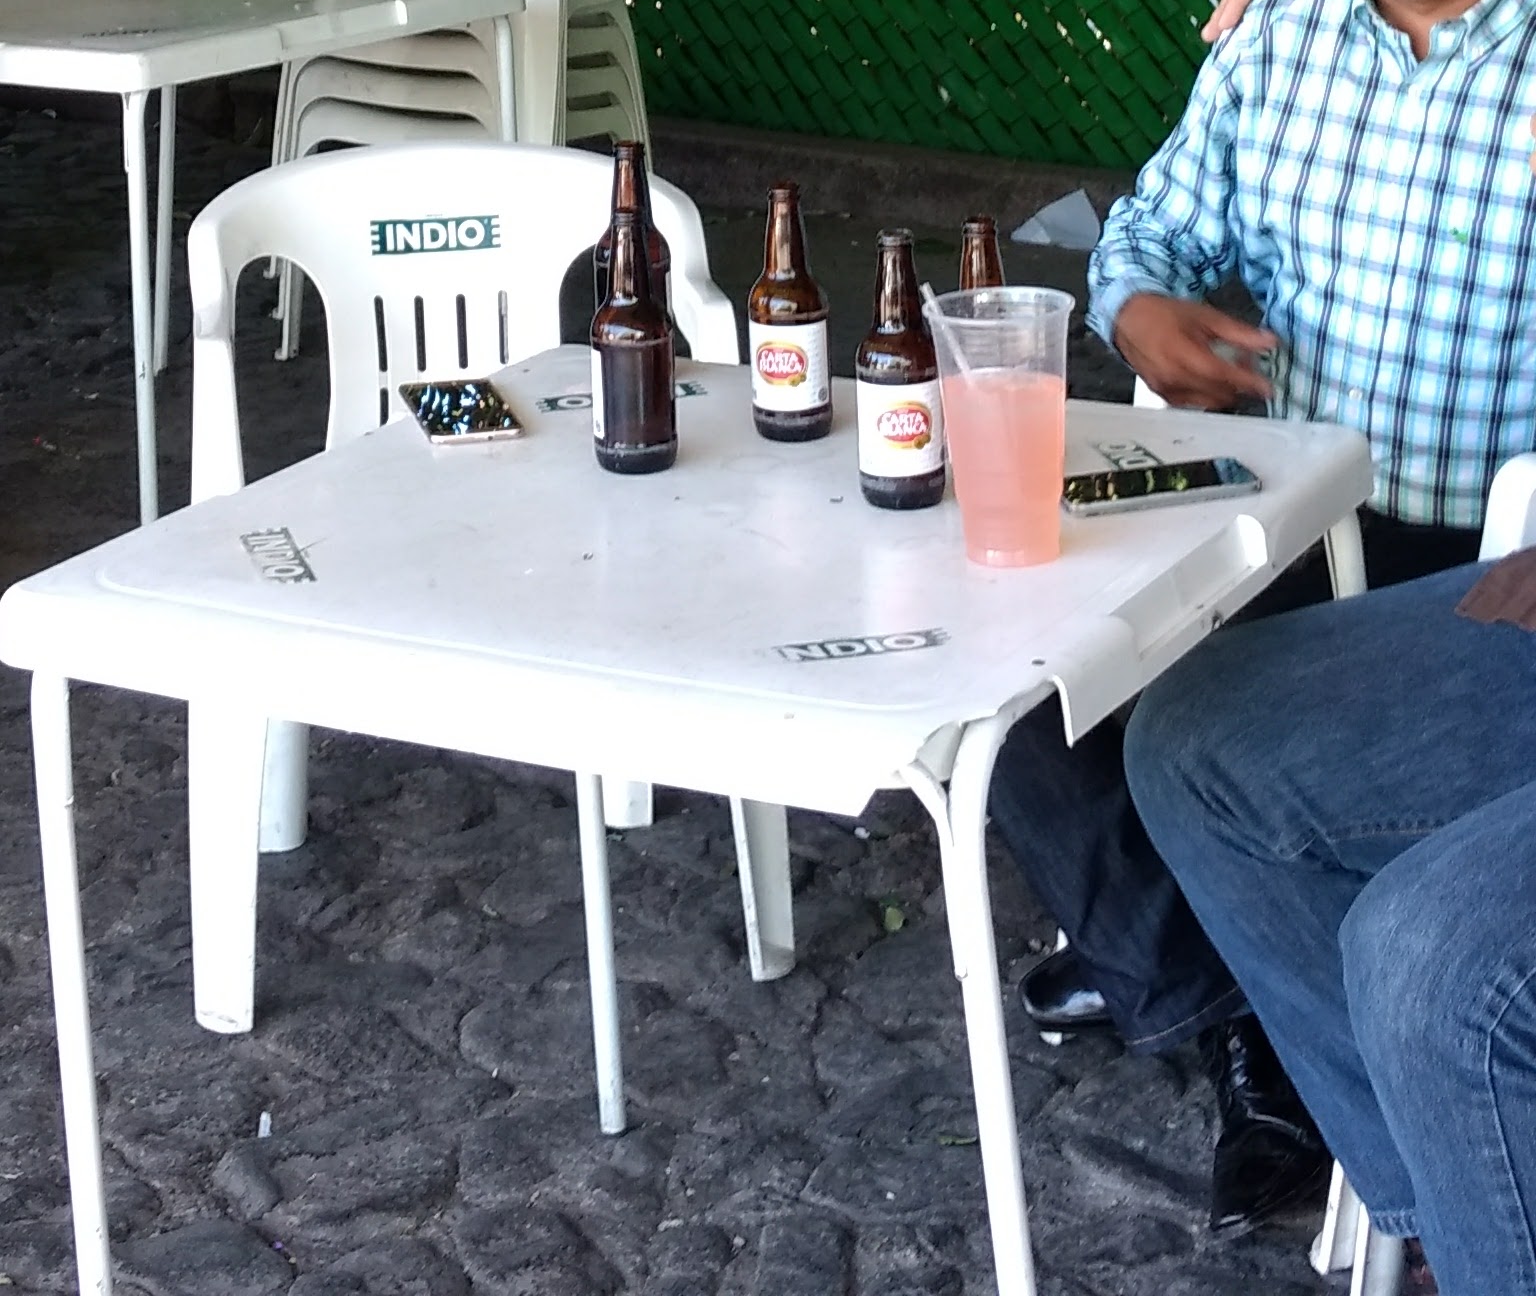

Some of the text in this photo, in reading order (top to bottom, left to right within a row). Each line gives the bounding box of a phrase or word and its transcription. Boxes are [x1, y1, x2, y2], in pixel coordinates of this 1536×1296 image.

[384, 218, 486, 252] INDIO
[761, 350, 799, 364] CARTA
[881, 412, 924, 424] CARTA
[1098, 442, 1160, 472] DIO
